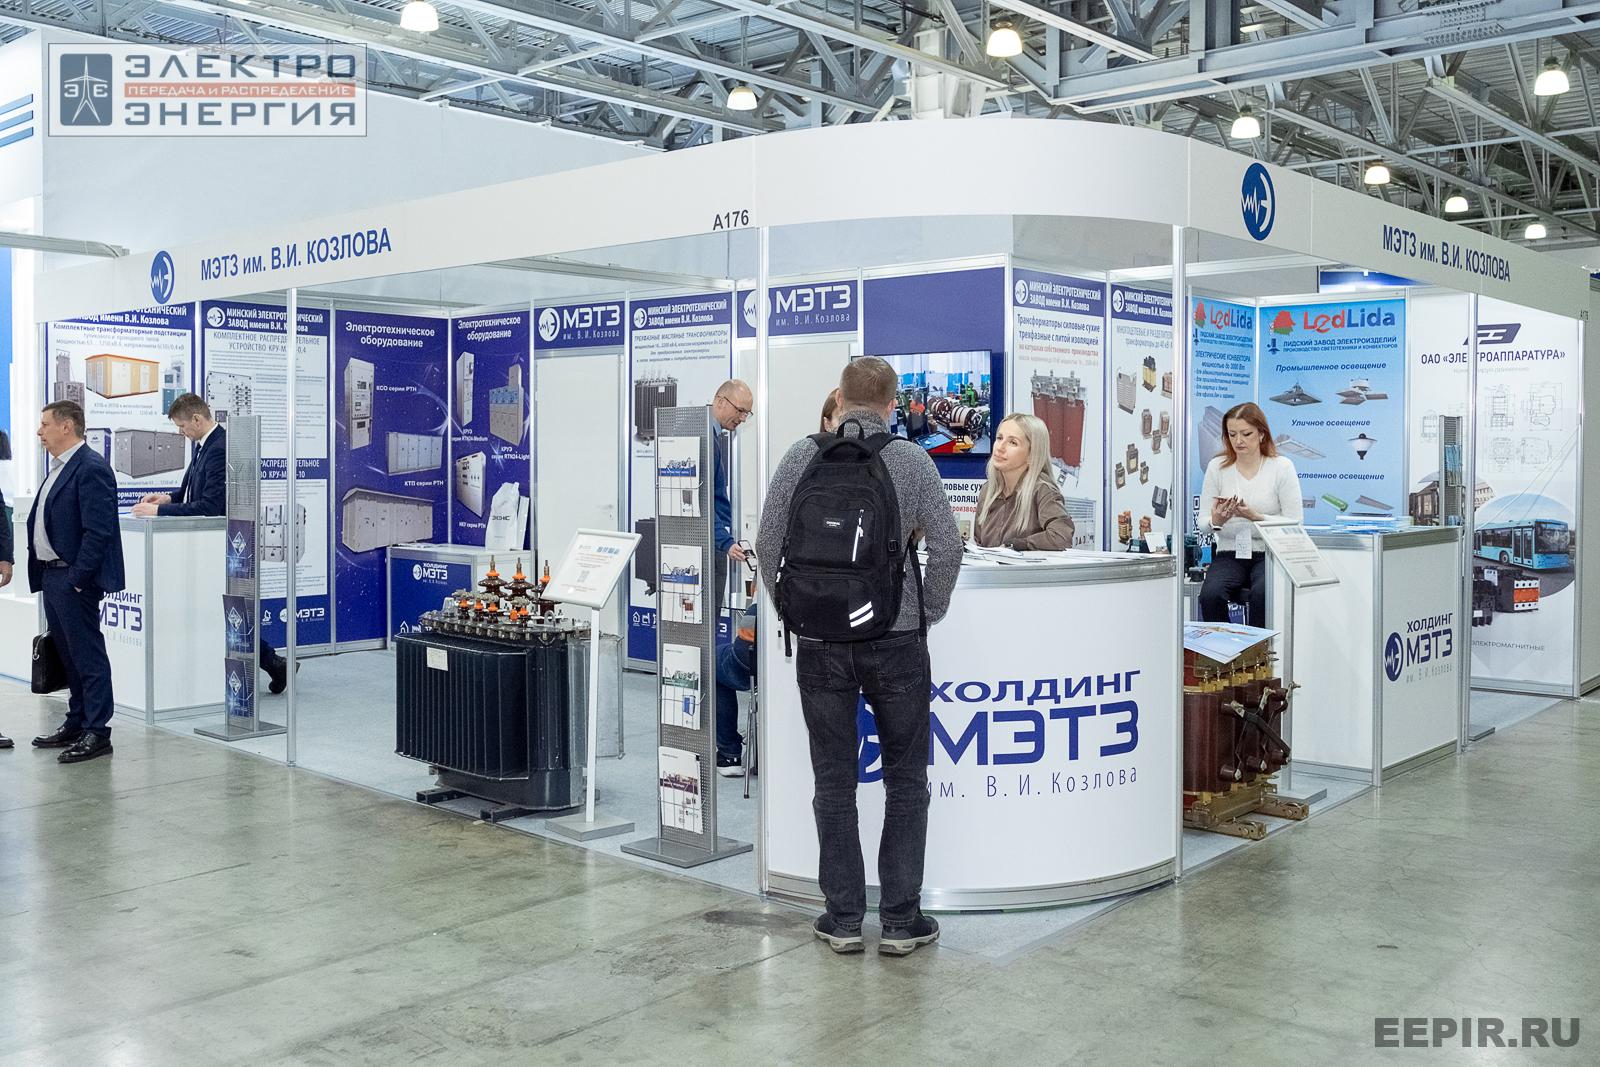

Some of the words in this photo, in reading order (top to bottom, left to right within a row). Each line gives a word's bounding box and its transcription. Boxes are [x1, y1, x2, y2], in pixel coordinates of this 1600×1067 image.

[201, 254, 238, 281] МЭТЗ
[243, 255, 266, 275] им.
[271, 244, 301, 270] В.И.
[307, 228, 392, 265] КОЗЛОВА
[1383, 225, 1416, 258] МЭТЗ
[1420, 241, 1438, 264] им.
[1442, 242, 1462, 270] В.И.
[1465, 249, 1511, 282] КОЗЛОВА
[775, 284, 851, 314] МЭТЗ
[141, 315, 169, 326] Козлова
[226, 308, 257, 320] МИНСКИЙ
[563, 305, 620, 329] МЭТЗ
[815, 313, 850, 324] Козлова
[1210, 304, 1252, 330] LedLida
[1303, 307, 1395, 333] LedLida
[228, 318, 249, 331] ЗАВОД
[345, 321, 435, 338] Электротехническое
[458, 317, 521, 332] Электротехническое
[213, 332, 257, 343] КОМПЛЕКТНОЕ
[360, 335, 423, 348] оборудование
[467, 328, 511, 342] оборудование
[229, 341, 267, 352] УСТРОЙСТВО
[1284, 338, 1312, 347] ЛИДСКИЙ
[1313, 339, 1335, 347] ЗАВОД
[1336, 337, 1397, 346] ЭЛЕКТРОИЗДЕЛИЙ
[1421, 353, 1441, 364] ОАО
[1276, 364, 1339, 373] Промышленное
[1340, 363, 1387, 371] освещение
[1291, 419, 1325, 427] Уличное
[1339, 473, 1385, 481] освещение
[944, 482, 969, 491] ловые
[423, 568, 448, 580] МЭТЗ
[1406, 612, 1453, 633] ХОЛДИНГ
[1406, 628, 1452, 667] МЭТЗ
[930, 670, 1140, 706] ХОЛДИНГ
[930, 700, 1139, 766] МЭТЗ
[1052, 767, 1137, 794] Козлова
